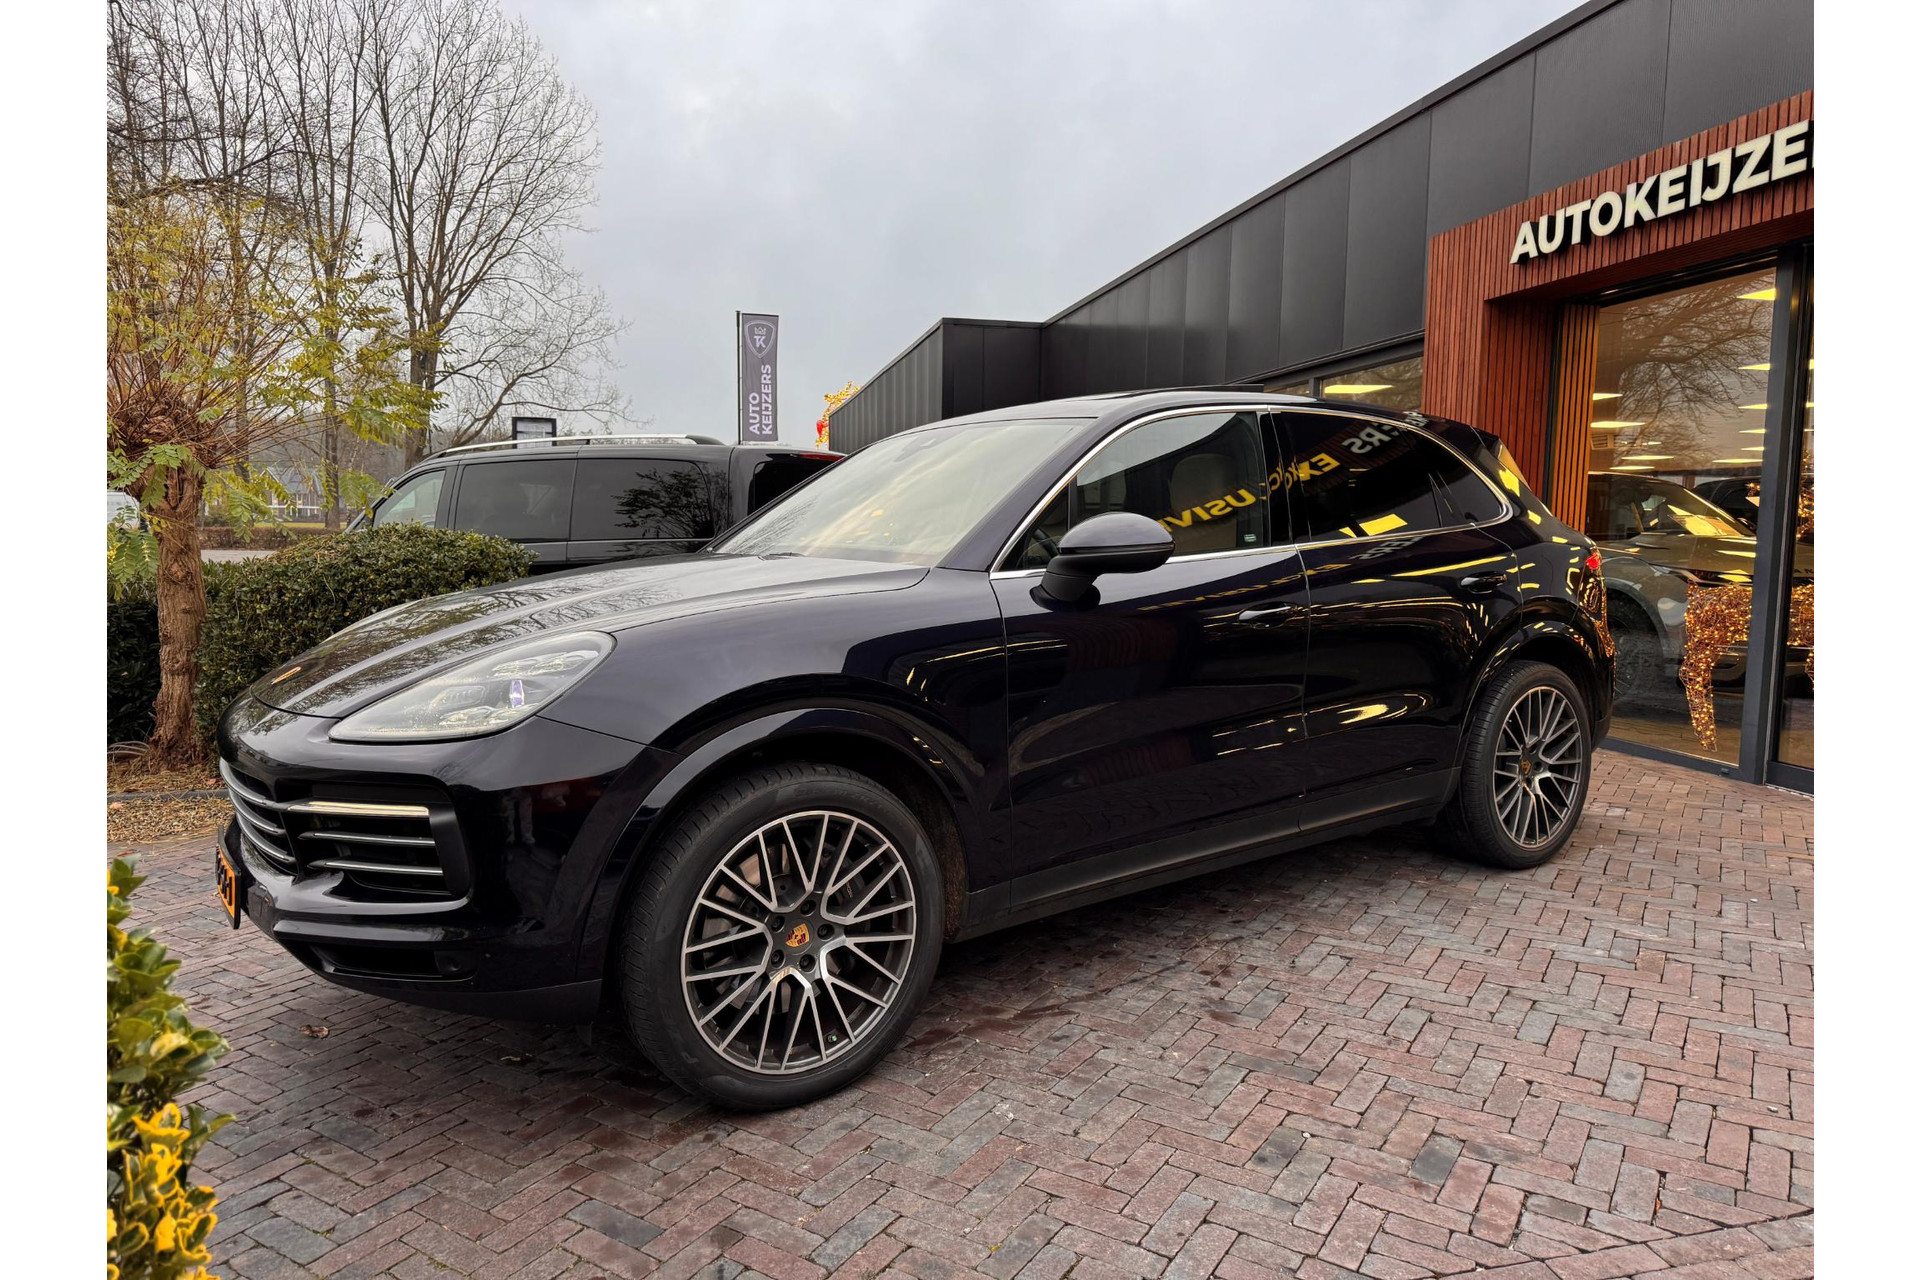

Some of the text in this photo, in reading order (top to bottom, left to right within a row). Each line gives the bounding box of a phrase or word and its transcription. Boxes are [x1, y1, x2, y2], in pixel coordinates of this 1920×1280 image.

[1510, 119, 1814, 264] AUTOKEIJZE
[749, 392, 760, 435] AUTO
[761, 364, 772, 434] KEIJZERS
